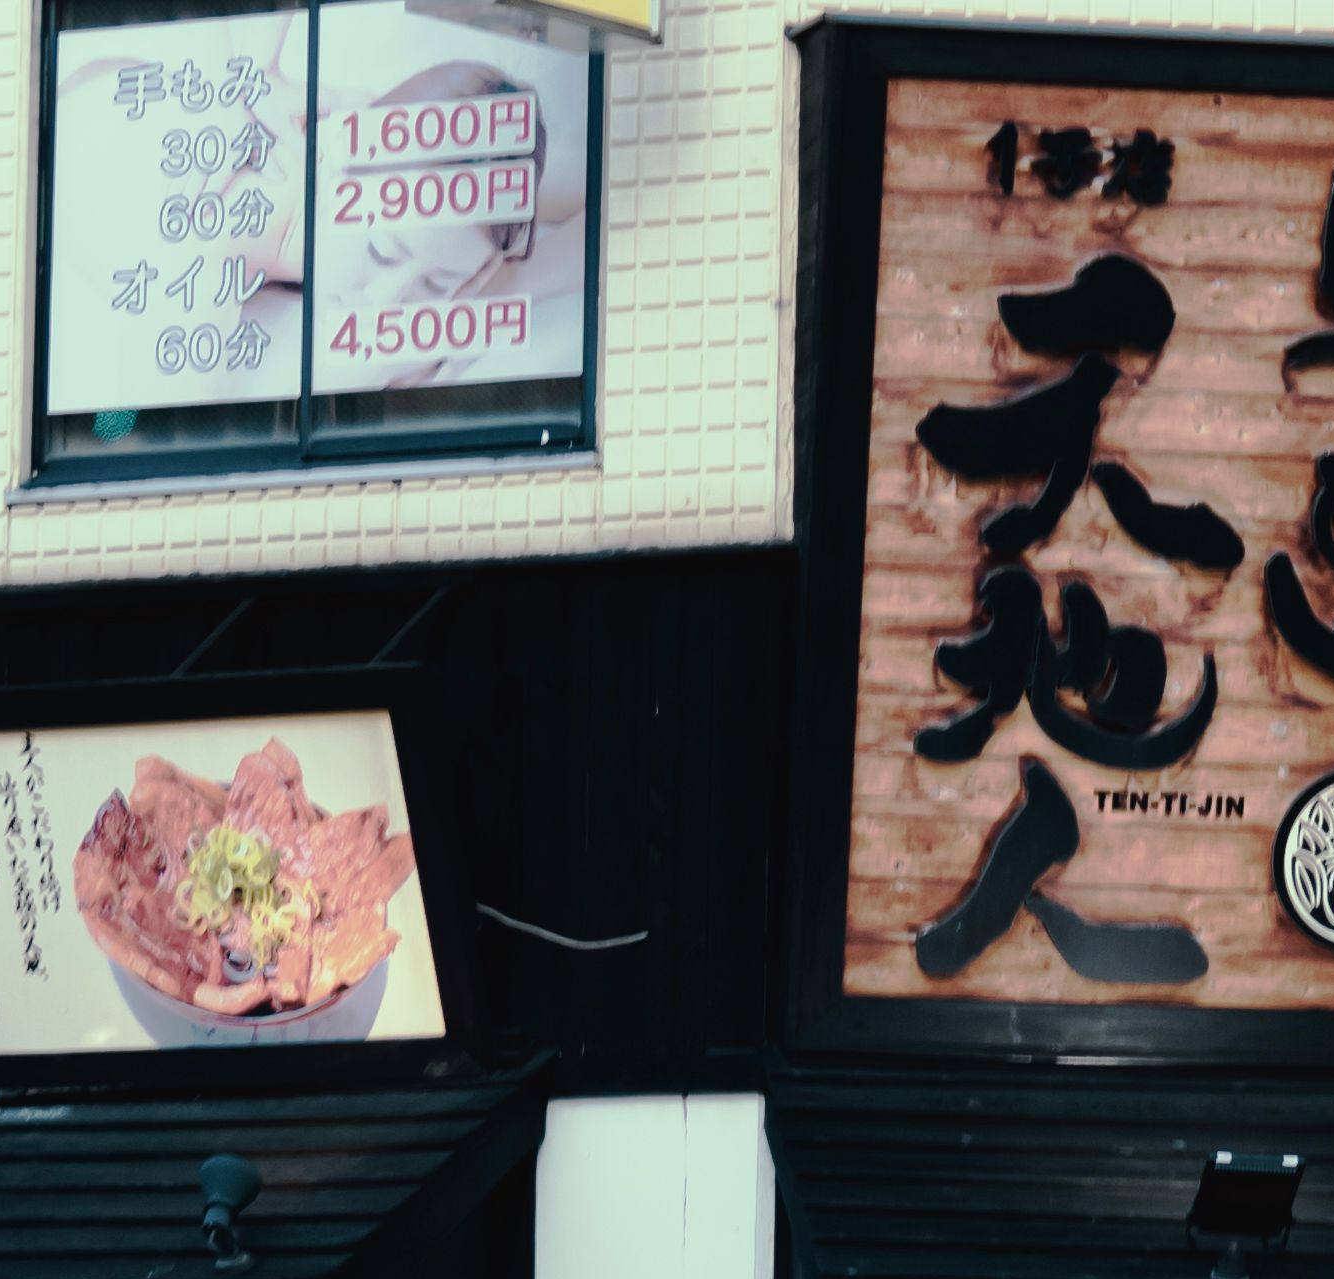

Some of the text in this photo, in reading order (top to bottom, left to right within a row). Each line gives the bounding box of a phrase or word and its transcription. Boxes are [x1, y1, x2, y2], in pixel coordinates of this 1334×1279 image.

[113, 57, 272, 121] 手もみ
[160, 97, 532, 176] 30分 1,600円
[158, 165, 531, 242] 60分 2,900円
[112, 253, 267, 314] オイル
[154, 300, 529, 376] 60分 4,500円
[915, 252, 1246, 985] 天地人
[1093, 788, 1246, 820] TEN-TI-JIN
